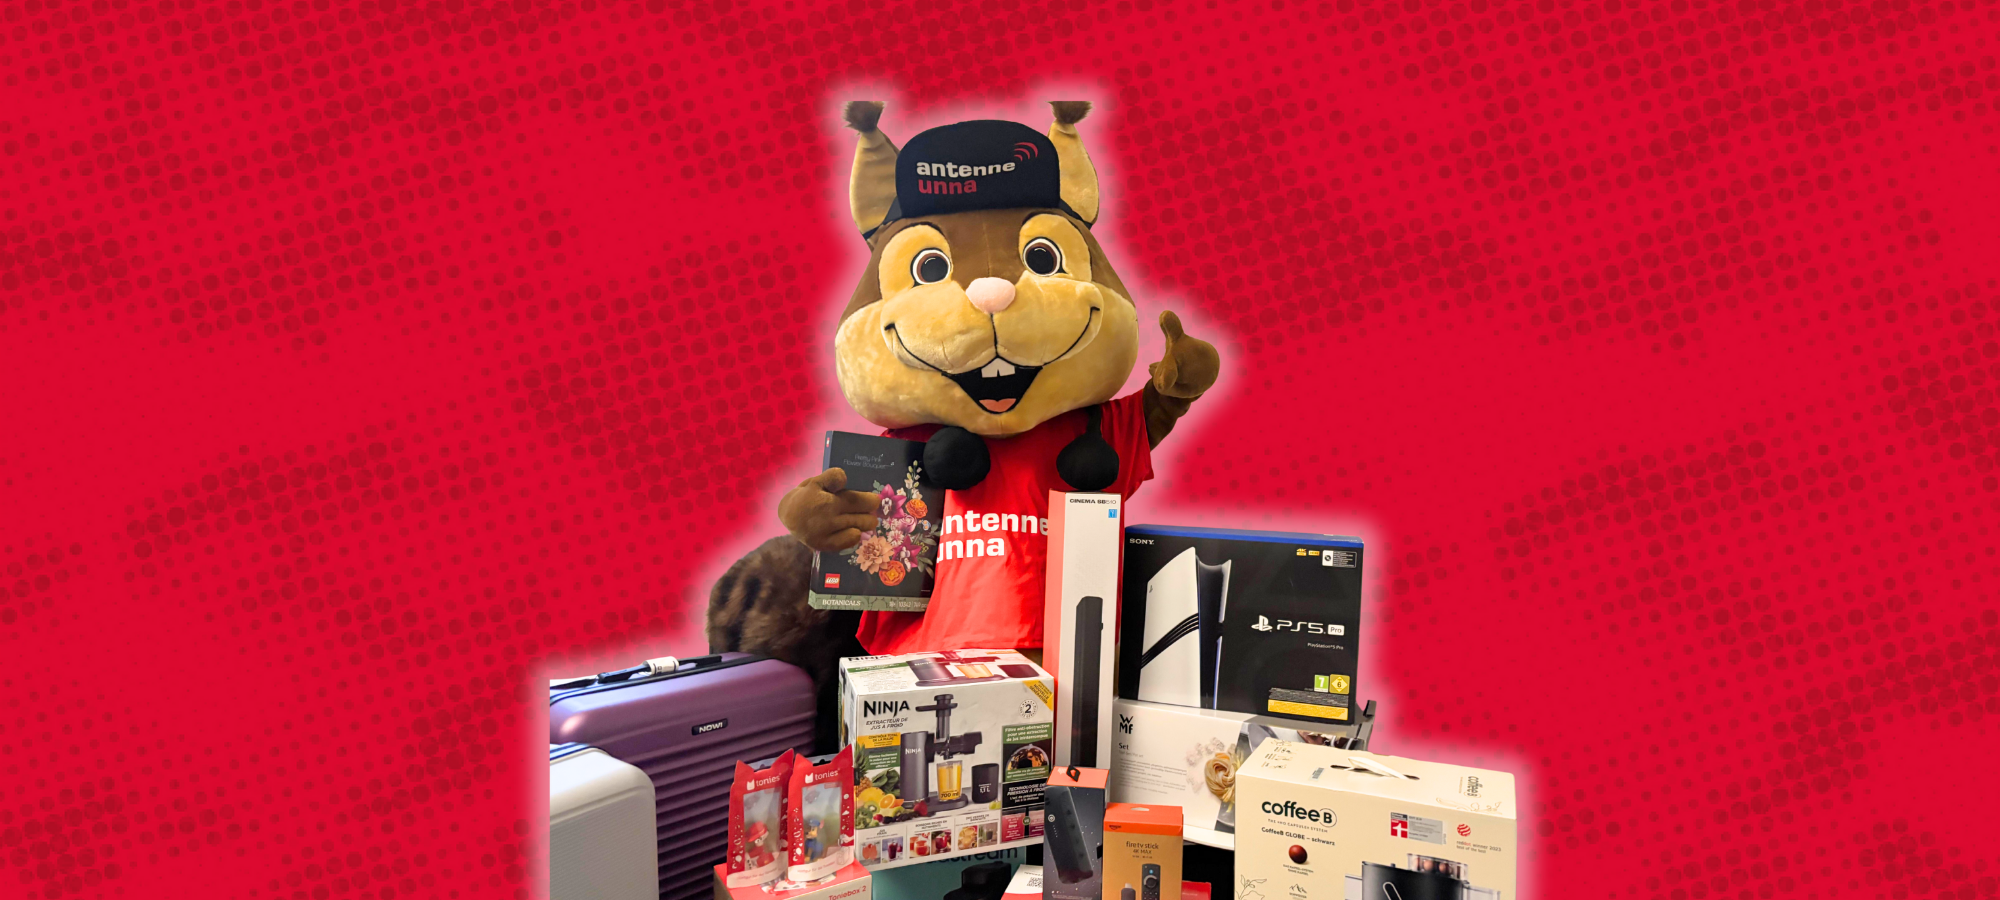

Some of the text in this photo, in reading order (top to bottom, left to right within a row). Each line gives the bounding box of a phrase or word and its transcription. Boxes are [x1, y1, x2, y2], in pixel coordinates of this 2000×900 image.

[916, 161, 1016, 178] antenne
[918, 180, 977, 194] unna
[1277, 620, 1324, 634] PS5
[1319, 677, 1325, 688] 7
[864, 700, 910, 718] NINJA
[1025, 704, 1031, 713] 2
[756, 775, 780, 786] tonies
[814, 770, 838, 780] tonies
[1262, 827, 1284, 836] CoffeeB
[1286, 831, 1305, 840] GLOBE
[1312, 837, 1335, 846] schwarz
[829, 889, 860, 900] Toniebox
